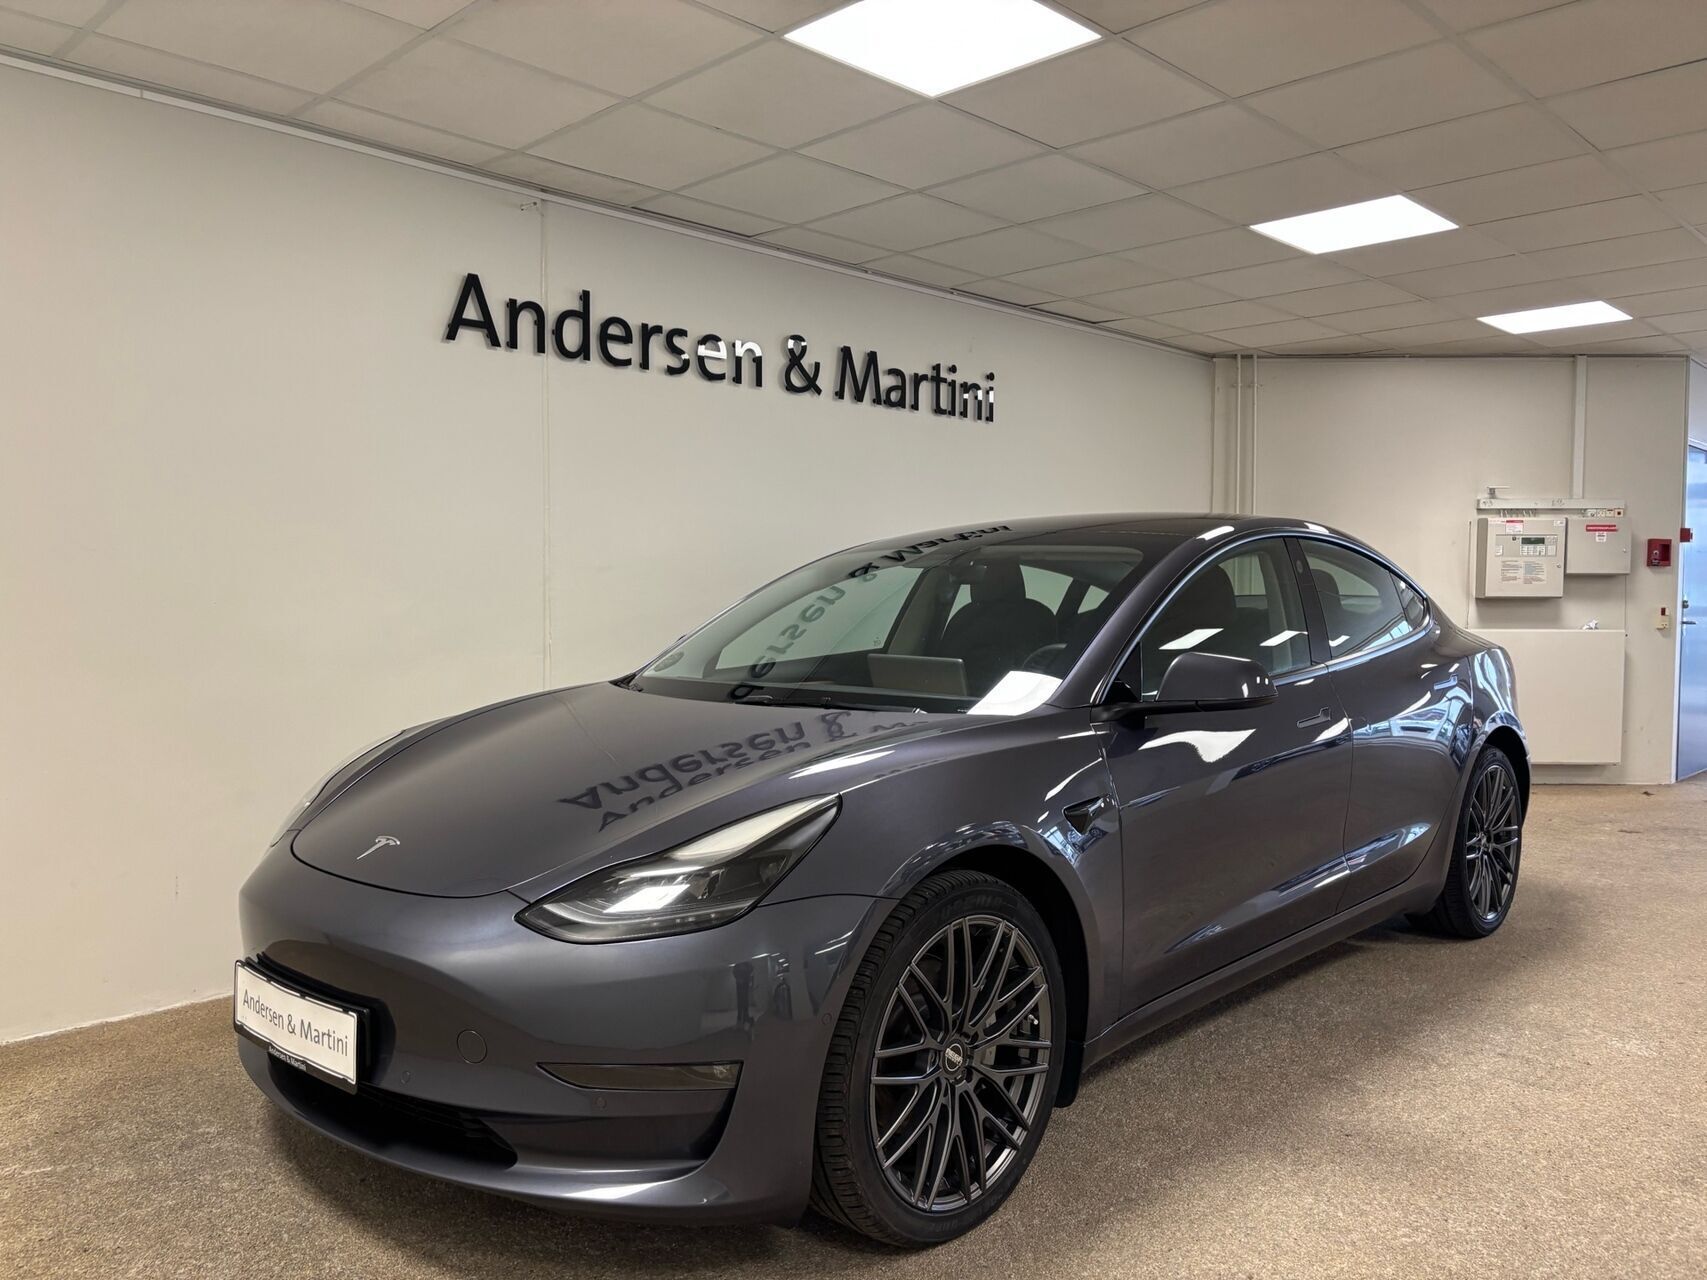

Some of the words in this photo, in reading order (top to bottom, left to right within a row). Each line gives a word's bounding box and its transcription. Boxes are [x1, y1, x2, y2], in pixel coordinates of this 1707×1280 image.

[445, 272, 763, 388] Andersen
[784, 334, 823, 396] &
[834, 344, 996, 423] Martini
[243, 989, 284, 1030] Andersen
[287, 1014, 296, 1035] &
[300, 1019, 348, 1056] Martini
